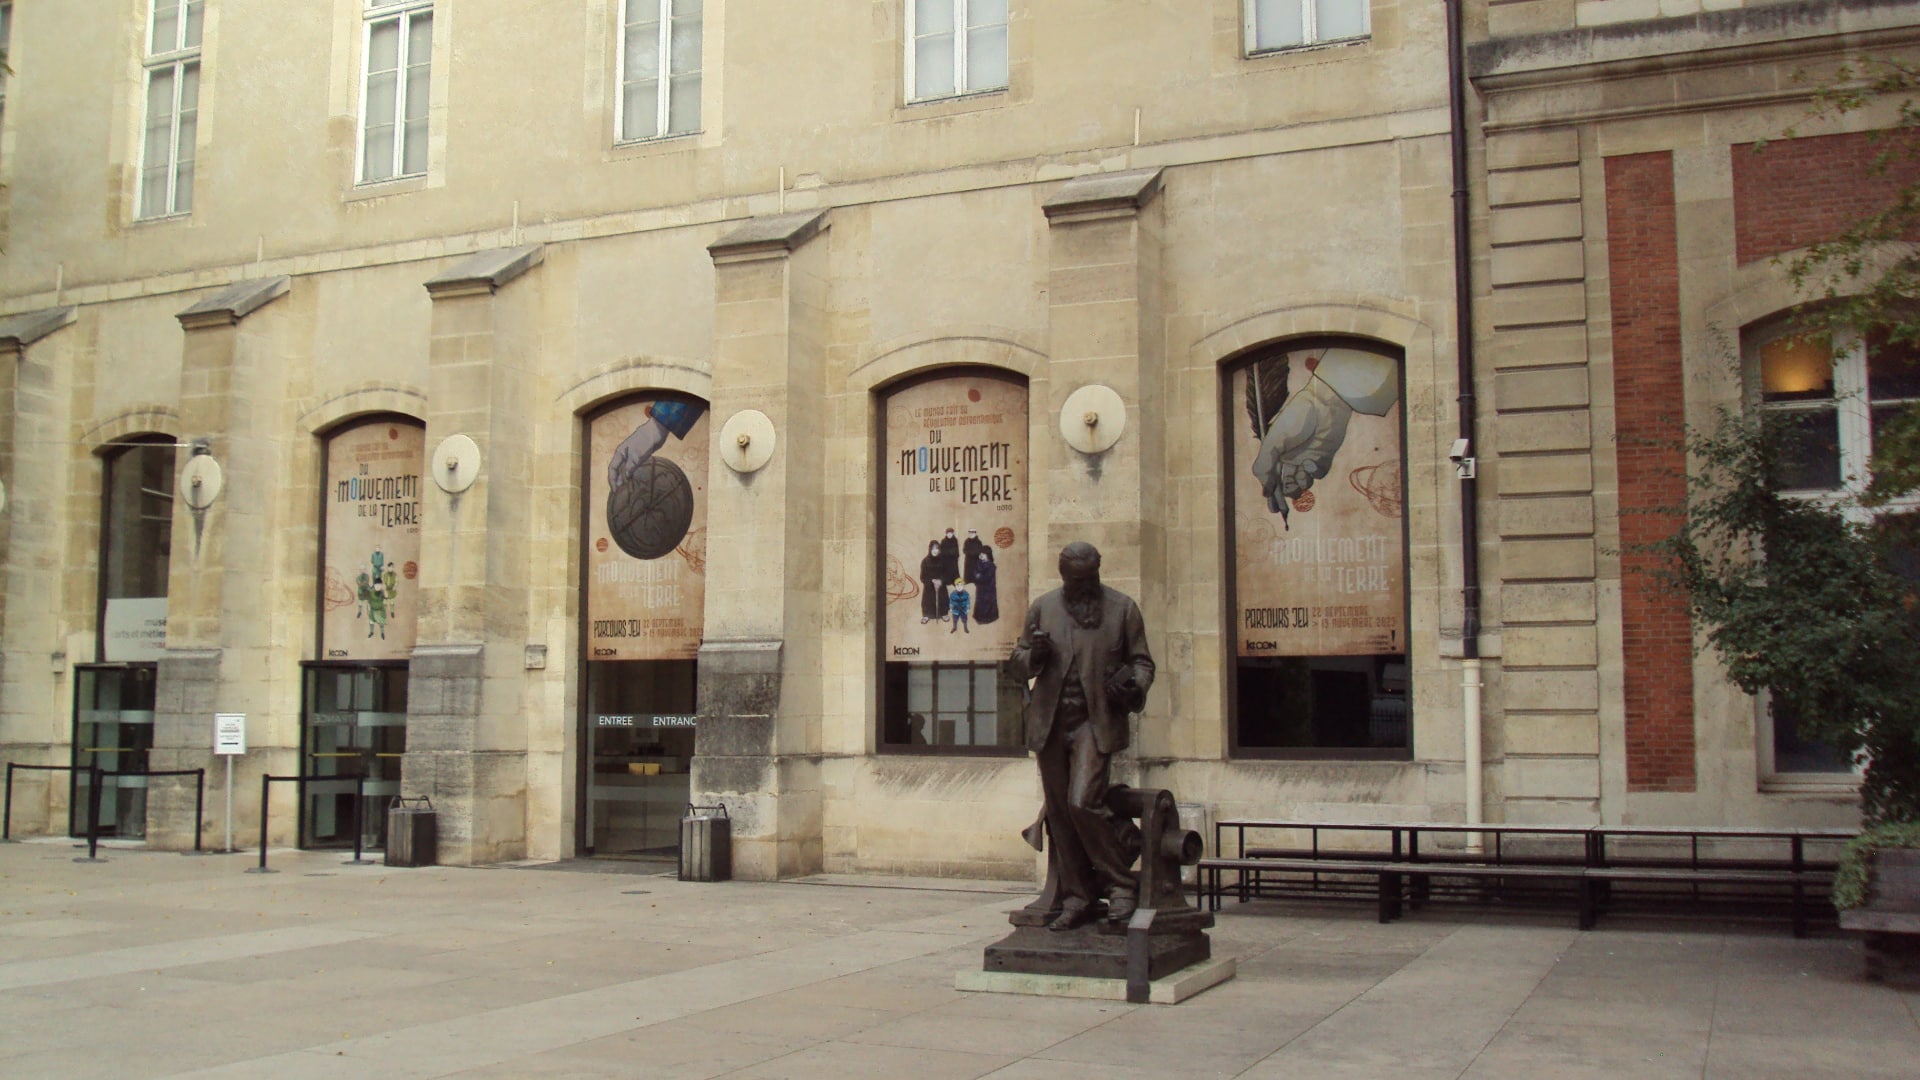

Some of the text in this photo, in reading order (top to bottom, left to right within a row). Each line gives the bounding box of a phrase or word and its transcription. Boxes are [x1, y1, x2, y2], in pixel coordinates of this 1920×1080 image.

[901, 441, 1010, 475] MOUVEMENT
[338, 474, 418, 503] MOUVEMENT
[930, 474, 1012, 504] DE LA TERRE
[380, 501, 419, 528] TERRE
[1271, 534, 1387, 565] MOUVEMENT
[598, 559, 680, 584] MOUVEMENT
[1336, 565, 1389, 594] TERRE
[641, 584, 680, 608] TERRE
[594, 619, 641, 638] PARCOURS JEU
[1245, 607, 1309, 629] PARCOURS JEU
[599, 716, 697, 726] ENTREE ENTRANC
